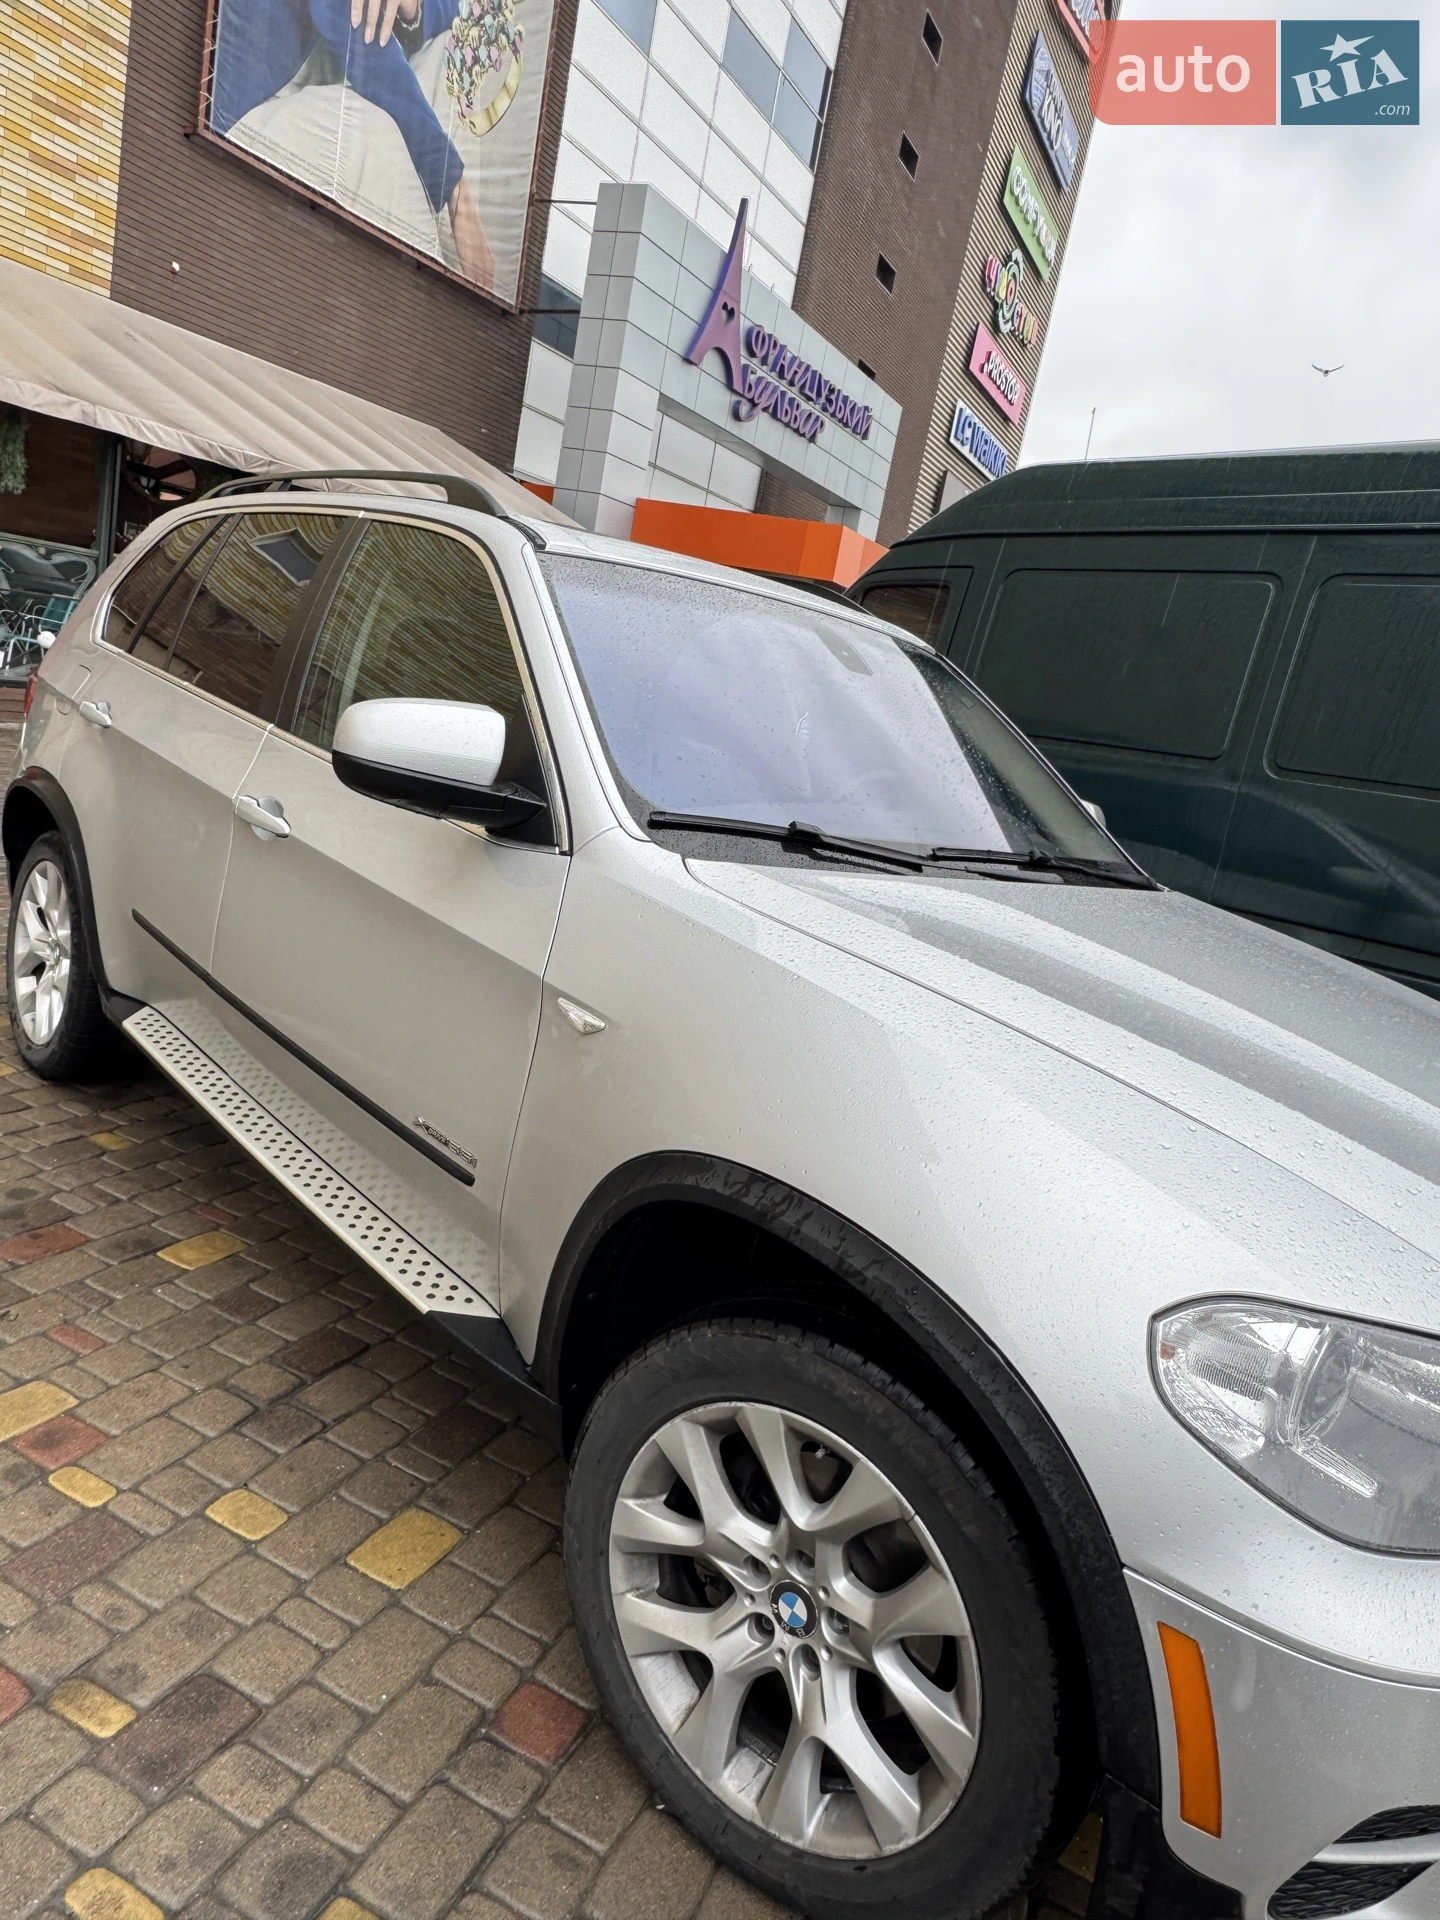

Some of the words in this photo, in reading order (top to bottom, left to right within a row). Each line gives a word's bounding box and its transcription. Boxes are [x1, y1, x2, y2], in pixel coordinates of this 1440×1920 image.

[747, 324, 873, 440] ФРАНЦУЗЬКИЙ
[954, 404, 975, 447] LC
[770, 1603, 806, 1637] BMW
